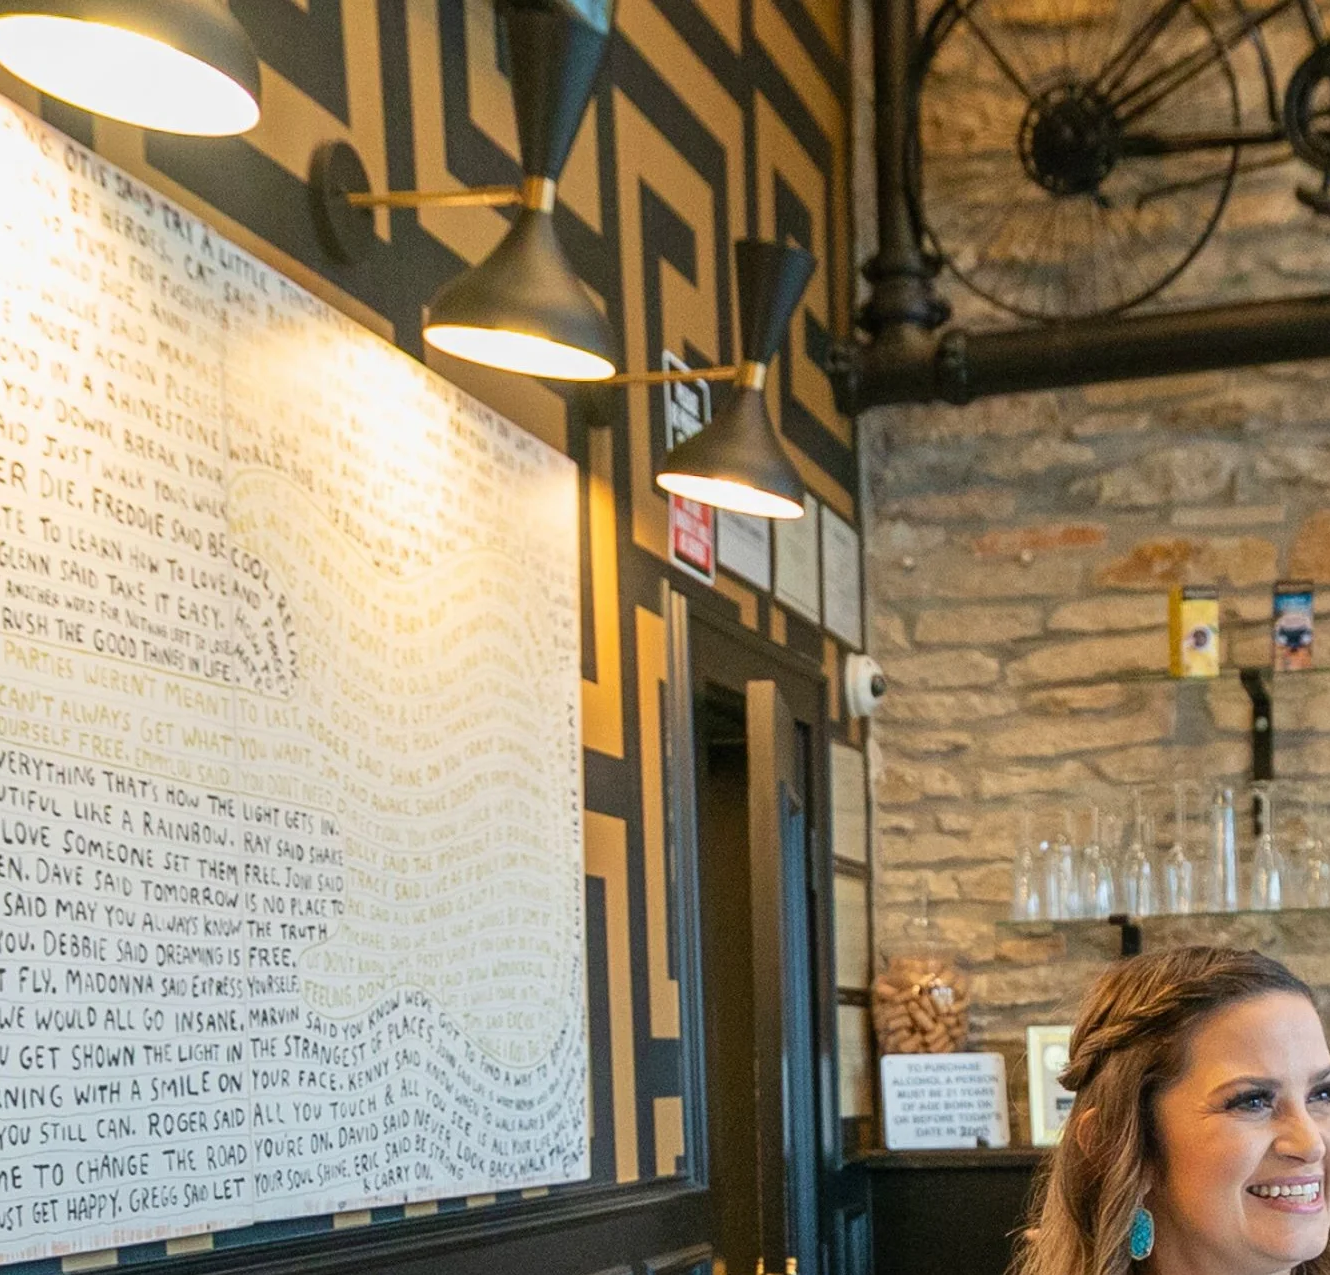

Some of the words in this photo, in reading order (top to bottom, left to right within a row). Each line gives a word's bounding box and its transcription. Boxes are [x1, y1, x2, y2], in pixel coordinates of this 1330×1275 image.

[19, 965, 57, 995] FLY.
[66, 968, 154, 994] MADONNA
[161, 977, 186, 998] SAID
[191, 974, 242, 999] EXPRESS
[36, 1006, 97, 1033] WOULD
[104, 1008, 135, 1032] ALL
[143, 1007, 164, 1032] GO
[175, 1009, 245, 1033] INSANE.
[249, 1007, 299, 1027] MARVIN
[19, 1045, 60, 1071] GET
[71, 1044, 135, 1071] SHOWN
[142, 1043, 172, 1065] THE
[177, 1043, 220, 1063] LIGHT
[226, 1043, 243, 1062] IN
[249, 1036, 277, 1059] THE
[284, 1034, 366, 1068] STRANGEST
[74, 1082, 121, 1106] WITH
[131, 1079, 141, 1100] A
[151, 1070, 210, 1102] SMILE
[218, 1073, 242, 1093] ON
[251, 1068, 290, 1090] YOUR
[298, 1069, 344, 1092] FACE.
[39, 1121, 88, 1145] STILL
[96, 1118, 136, 1139] CAN.
[147, 1110, 208, 1138] ROGER
[213, 1107, 245, 1131] SAID
[253, 1102, 285, 1127] ALL
[292, 1102, 322, 1122] YOU
[328, 1097, 377, 1120] TOUCH
[32, 1162, 64, 1187] TO
[76, 1152, 149, 1185] CHANGE
[161, 1148, 197, 1172] THE
[206, 1143, 248, 1169] ROAD
[311, 1132, 334, 1155] ON.
[338, 1122, 379, 1149] DAVID
[32, 1198, 59, 1224] GET
[66, 1190, 123, 1221] HAPPY.
[129, 1185, 178, 1213] GREGG
[183, 1182, 207, 1209] SAID
[213, 1176, 246, 1201] LET
[254, 1169, 283, 1194] YOUR
[286, 1168, 314, 1191] SOUL
